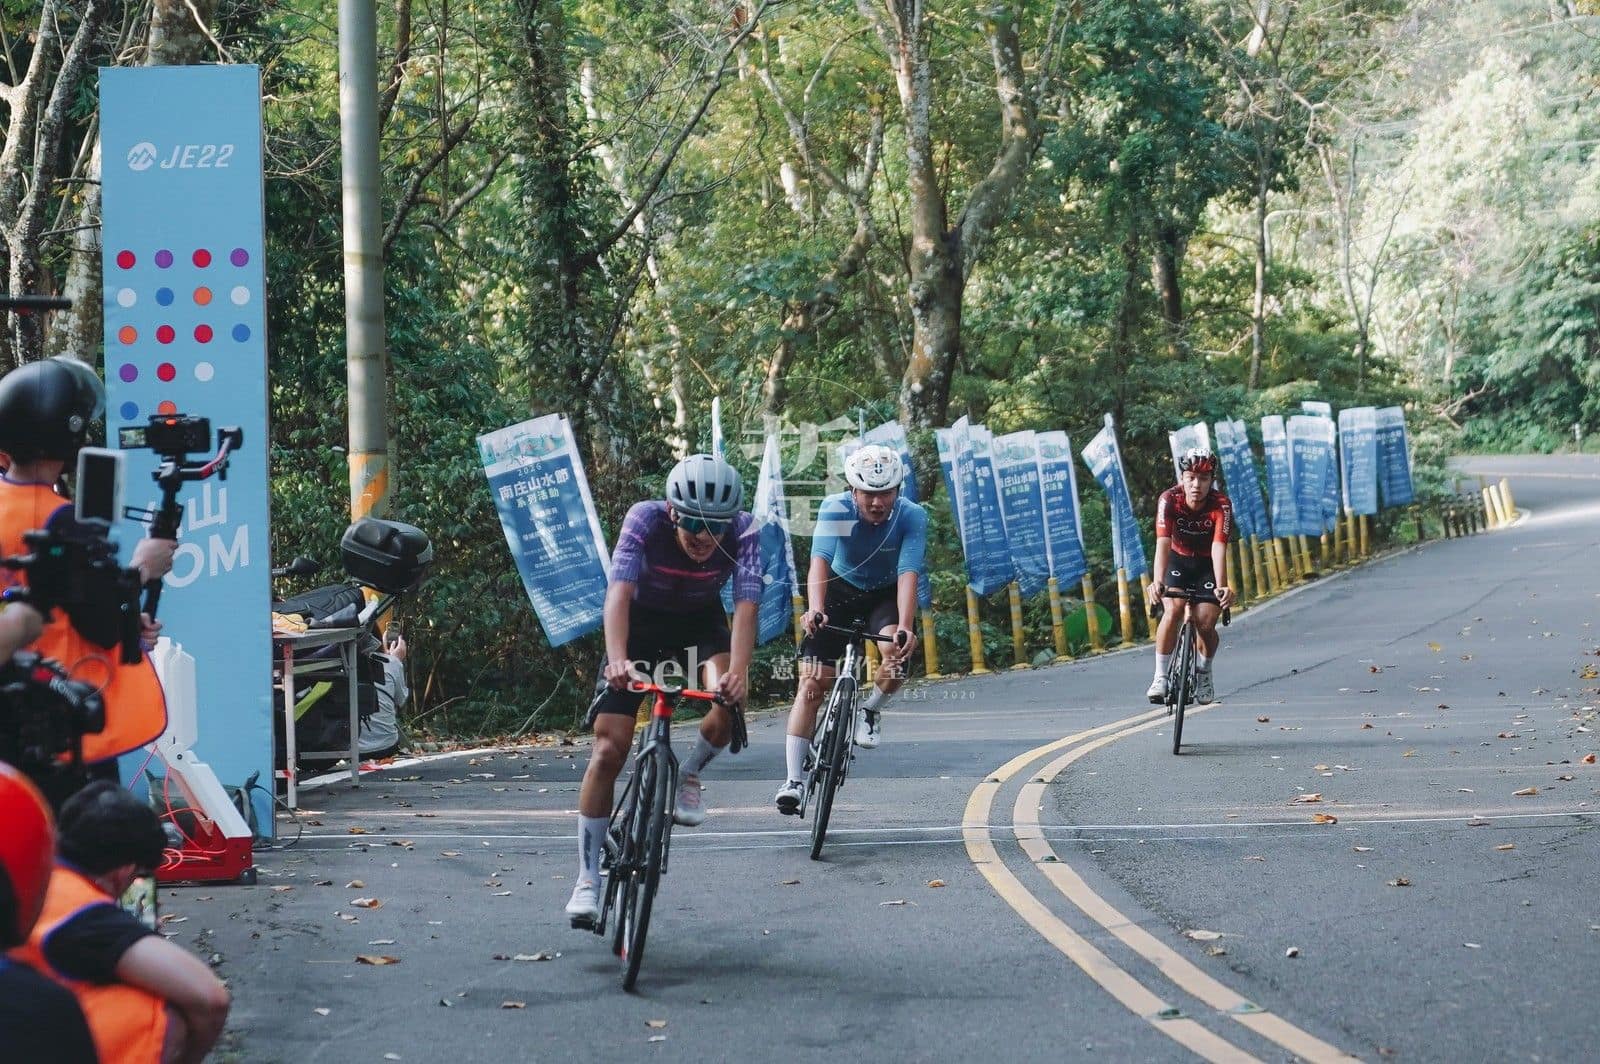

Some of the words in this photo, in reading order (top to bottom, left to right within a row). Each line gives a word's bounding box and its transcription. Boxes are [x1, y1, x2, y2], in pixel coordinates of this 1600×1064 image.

[160, 144, 234, 169] JE22
[499, 468, 569, 501] 南庄山水節
[516, 487, 559, 508] 系列活動
[161, 524, 249, 591] OM
